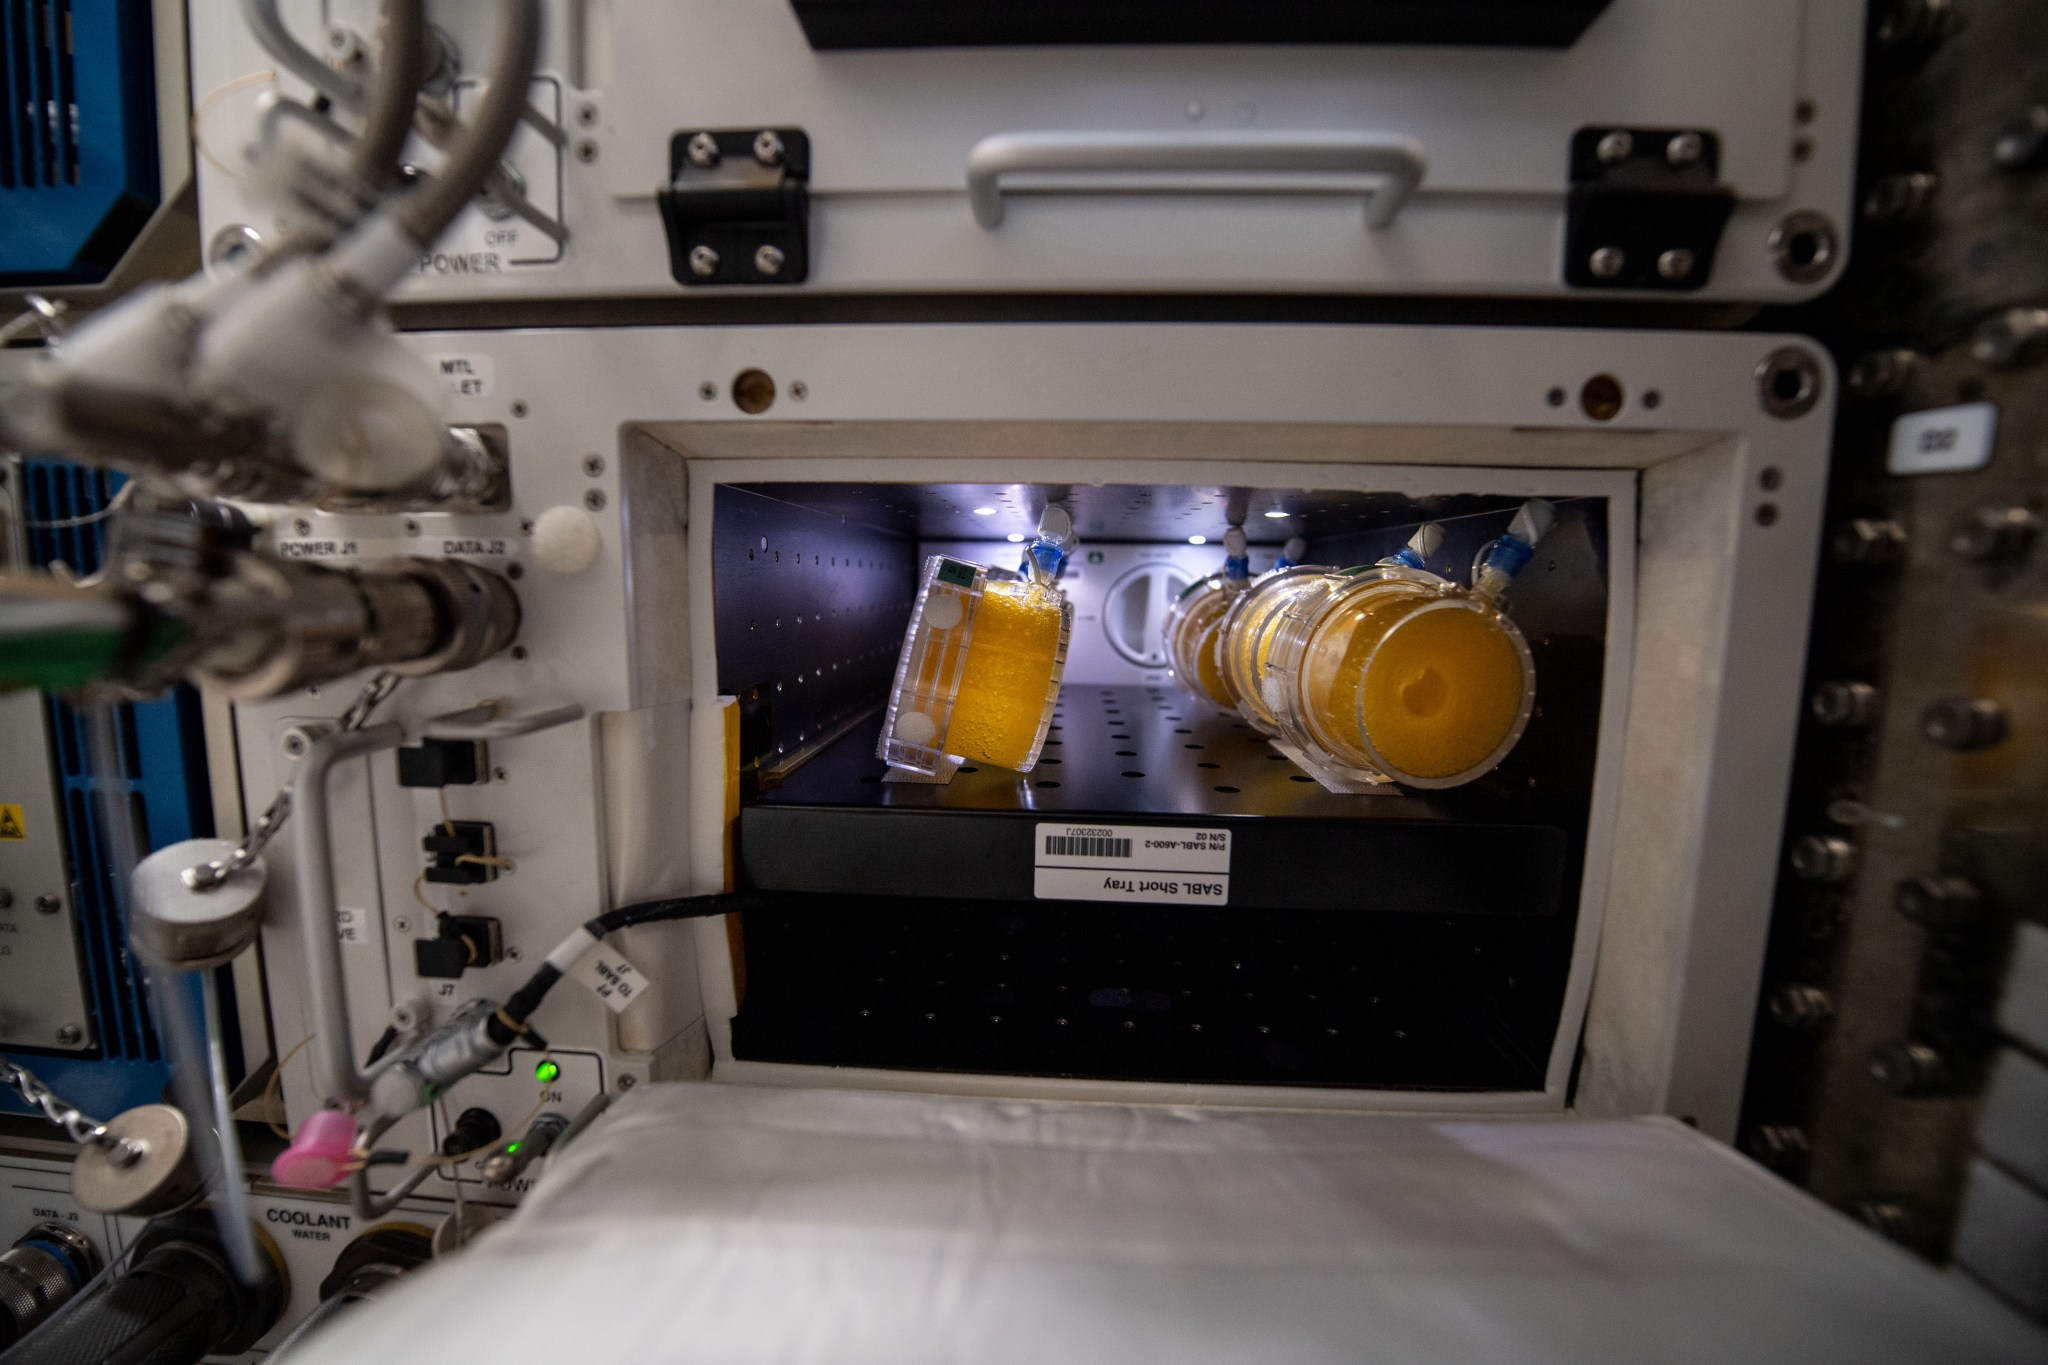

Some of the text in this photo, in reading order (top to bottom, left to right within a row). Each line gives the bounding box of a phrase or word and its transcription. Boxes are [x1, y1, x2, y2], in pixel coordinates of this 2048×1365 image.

[484, 229, 518, 248] OFF
[419, 252, 502, 275] POWER
[279, 541, 337, 557] POWER
[443, 540, 485, 555] DATA
[1066, 827, 1113, 837] 00232307J
[1195, 832, 1227, 841] S/N 02
[1144, 839, 1226, 851] P/N SABL-A600-2
[1103, 877, 1223, 896] SABL Short Tray
[438, 983, 456, 997] J7
[617, 982, 634, 998] TO
[539, 1090, 562, 1103] ON
[32, 1207, 60, 1219] DATA
[266, 1208, 350, 1230] COOLANT
[291, 1230, 330, 1242] WATER
